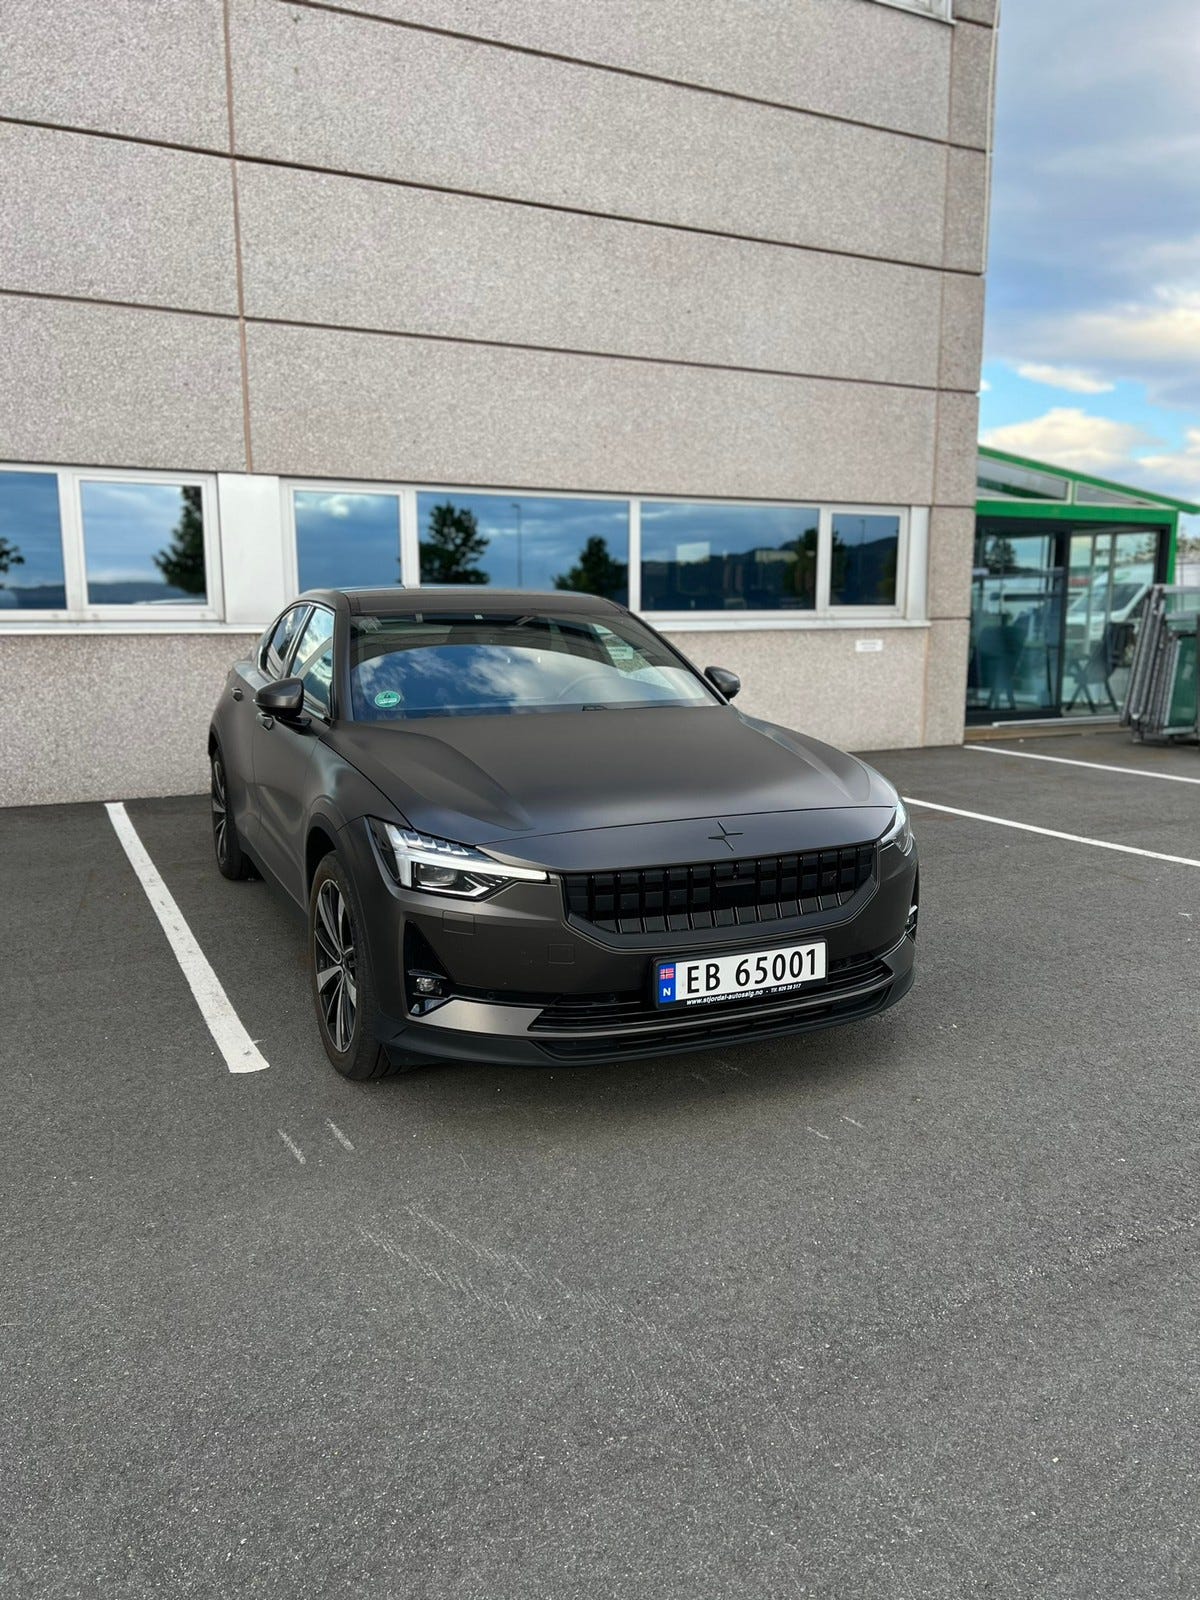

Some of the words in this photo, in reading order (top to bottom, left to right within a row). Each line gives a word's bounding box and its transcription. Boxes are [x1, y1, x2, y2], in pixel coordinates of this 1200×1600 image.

[687, 963, 720, 994] EB
[735, 949, 816, 986] 65001
[663, 988, 671, 997] N
